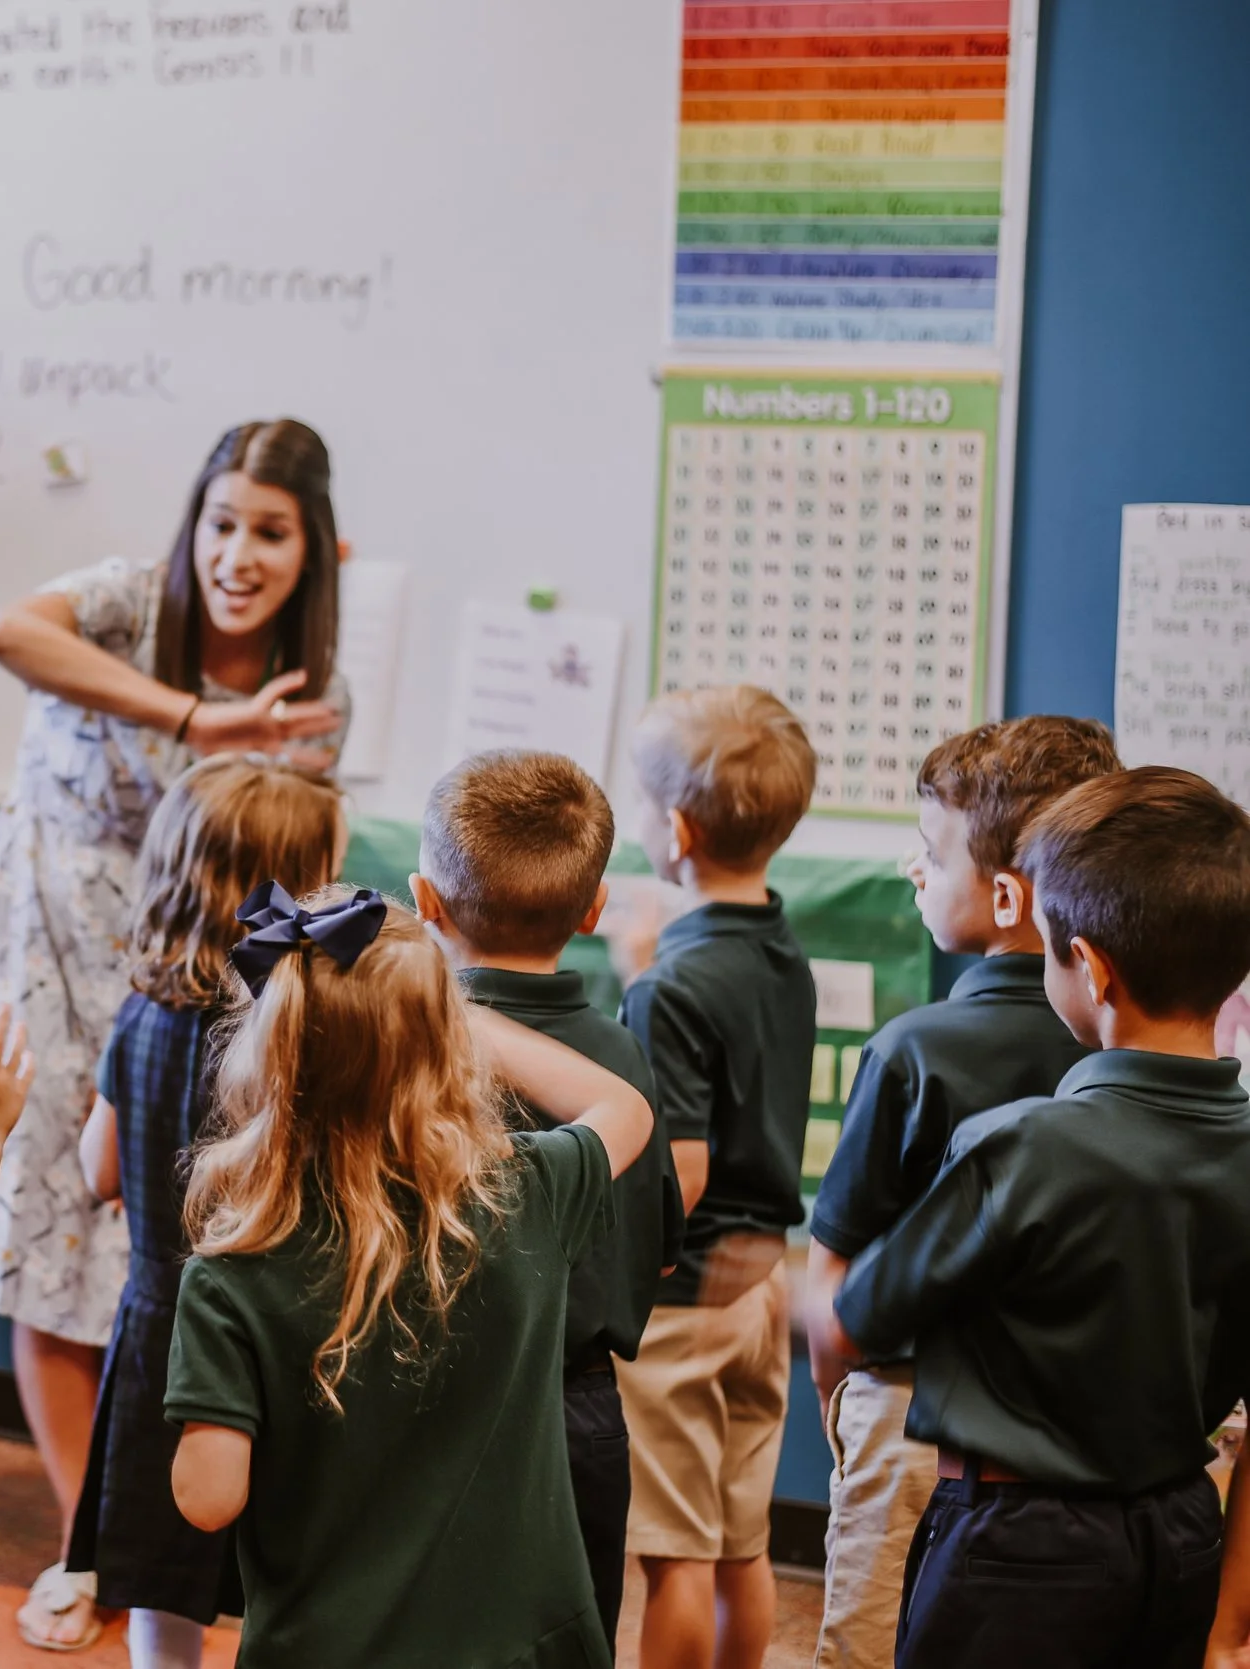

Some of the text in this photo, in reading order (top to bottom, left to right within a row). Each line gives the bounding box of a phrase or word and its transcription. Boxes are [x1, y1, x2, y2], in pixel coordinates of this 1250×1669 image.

[21, 232, 396, 332] Good morning!
[19, 351, 178, 406] unpack
[704, 385, 952, 424] Numbers 1-120
